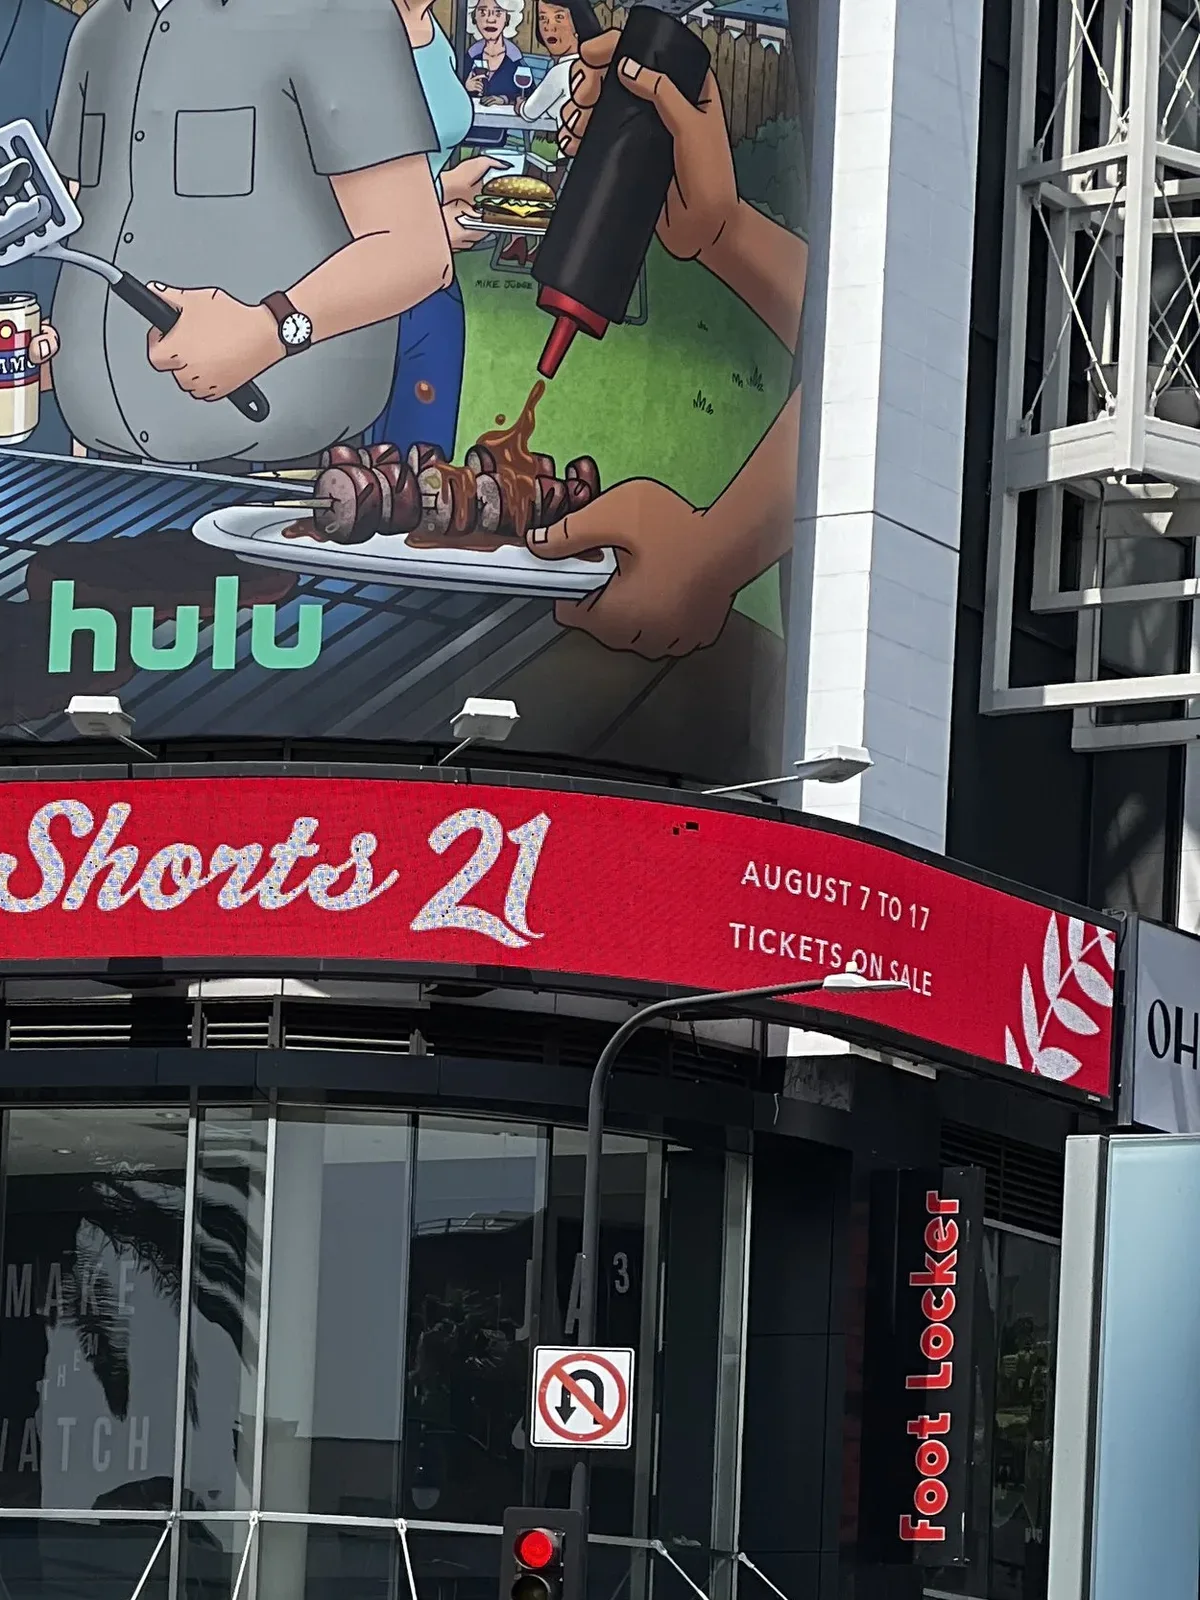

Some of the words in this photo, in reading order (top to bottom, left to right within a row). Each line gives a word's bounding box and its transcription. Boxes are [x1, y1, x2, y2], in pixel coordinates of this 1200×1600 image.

[474, 280, 500, 289] MIKE
[503, 280, 533, 290] JUDGE
[47, 575, 323, 673] hulu
[409, 807, 552, 949] 21
[741, 860, 852, 907] AUGUST
[860, 885, 871, 911] 7
[878, 891, 902, 922] TO
[910, 903, 931, 931] 17
[729, 922, 843, 969] TICKETS
[852, 948, 883, 980] ON
[889, 959, 933, 997] SALE
[5, 1259, 136, 1318] MAKE
[905, 1190, 960, 1390] Locker
[899, 1411, 952, 1542] Foot
